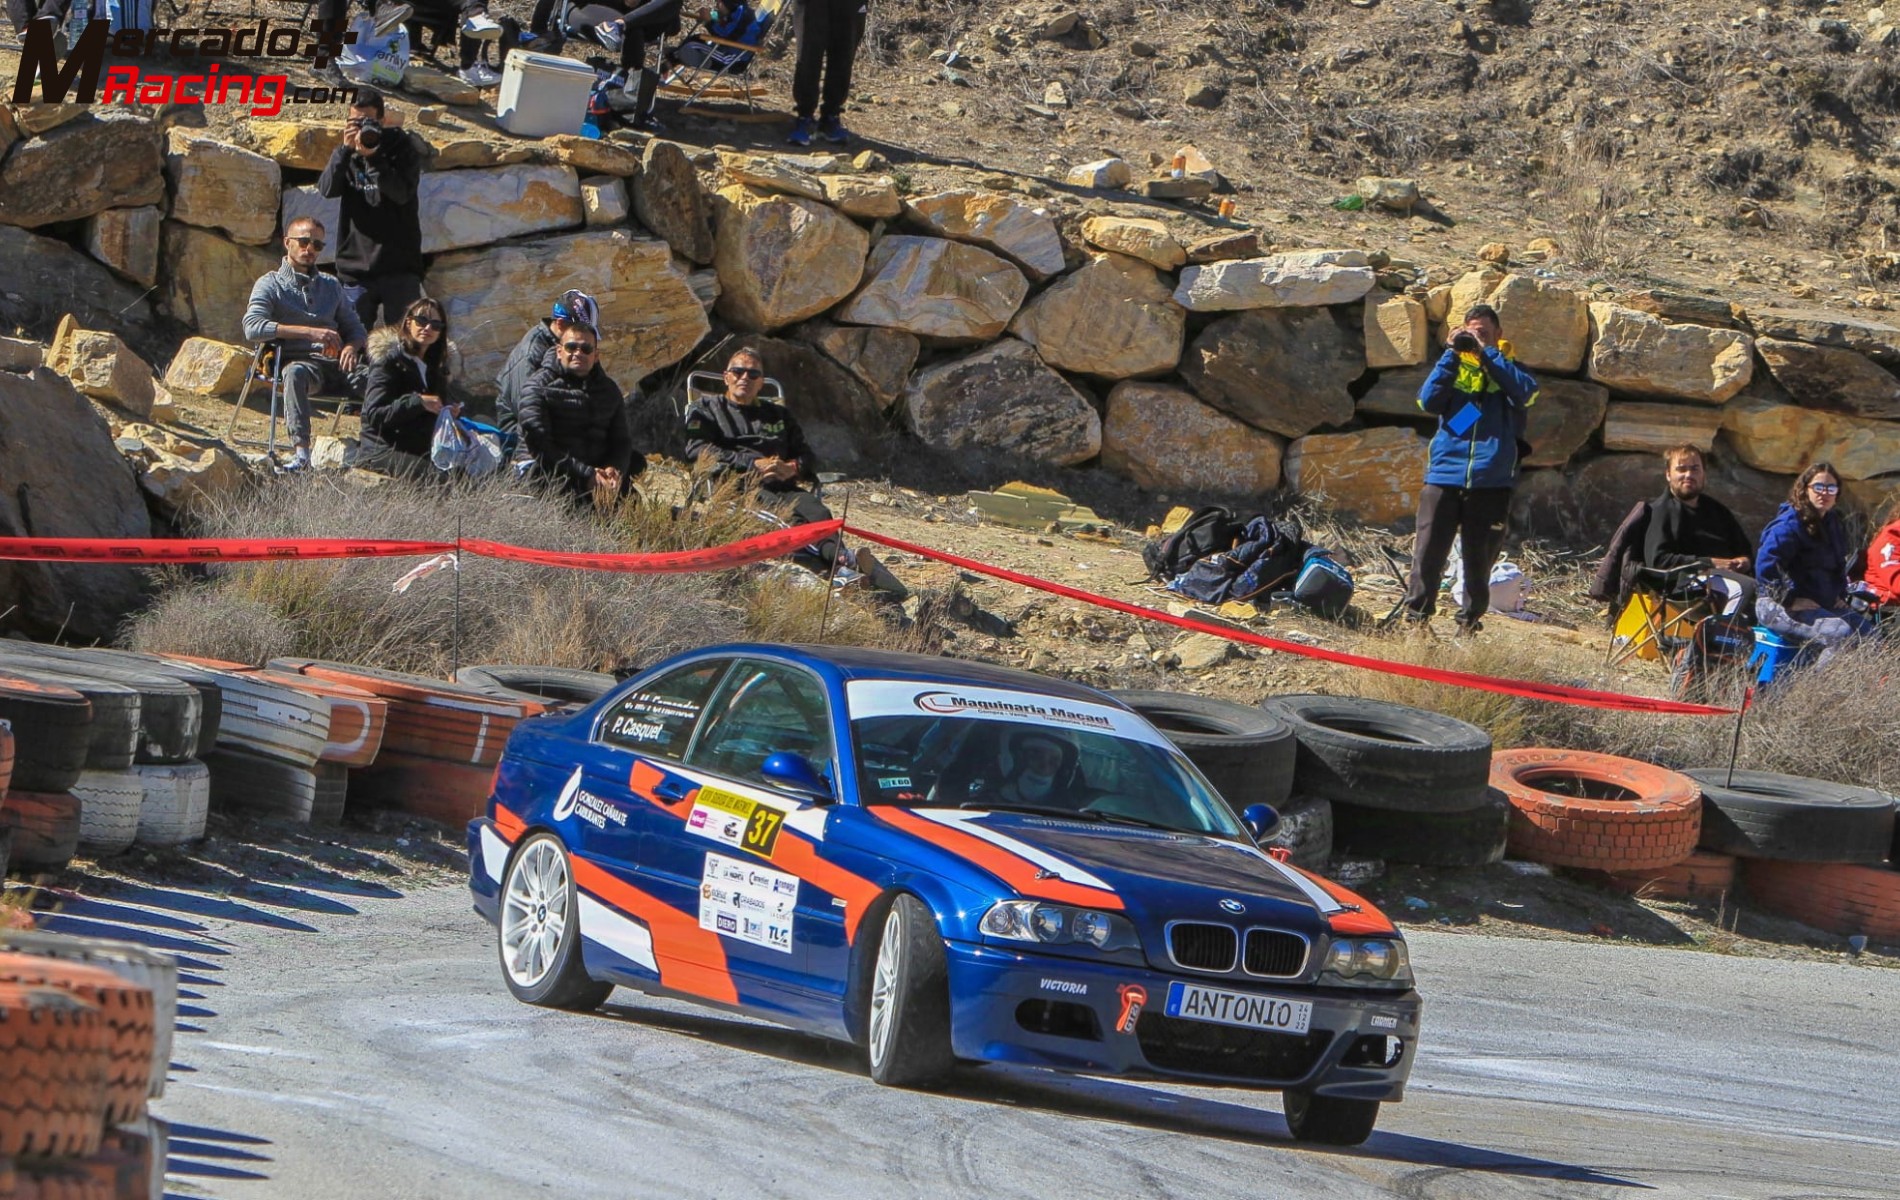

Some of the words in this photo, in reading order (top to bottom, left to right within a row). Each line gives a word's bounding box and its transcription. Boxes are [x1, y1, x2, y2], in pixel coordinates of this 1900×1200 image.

[950, 697, 1046, 715] Maquinaria
[1050, 707, 1110, 725] Macael
[622, 717, 664, 741] Casquet
[748, 809, 780, 847] 37
[1040, 978, 1088, 995] VICTORIA
[1184, 989, 1292, 1028] ANTONIO
[1371, 1015, 1398, 1029] CARMEN
